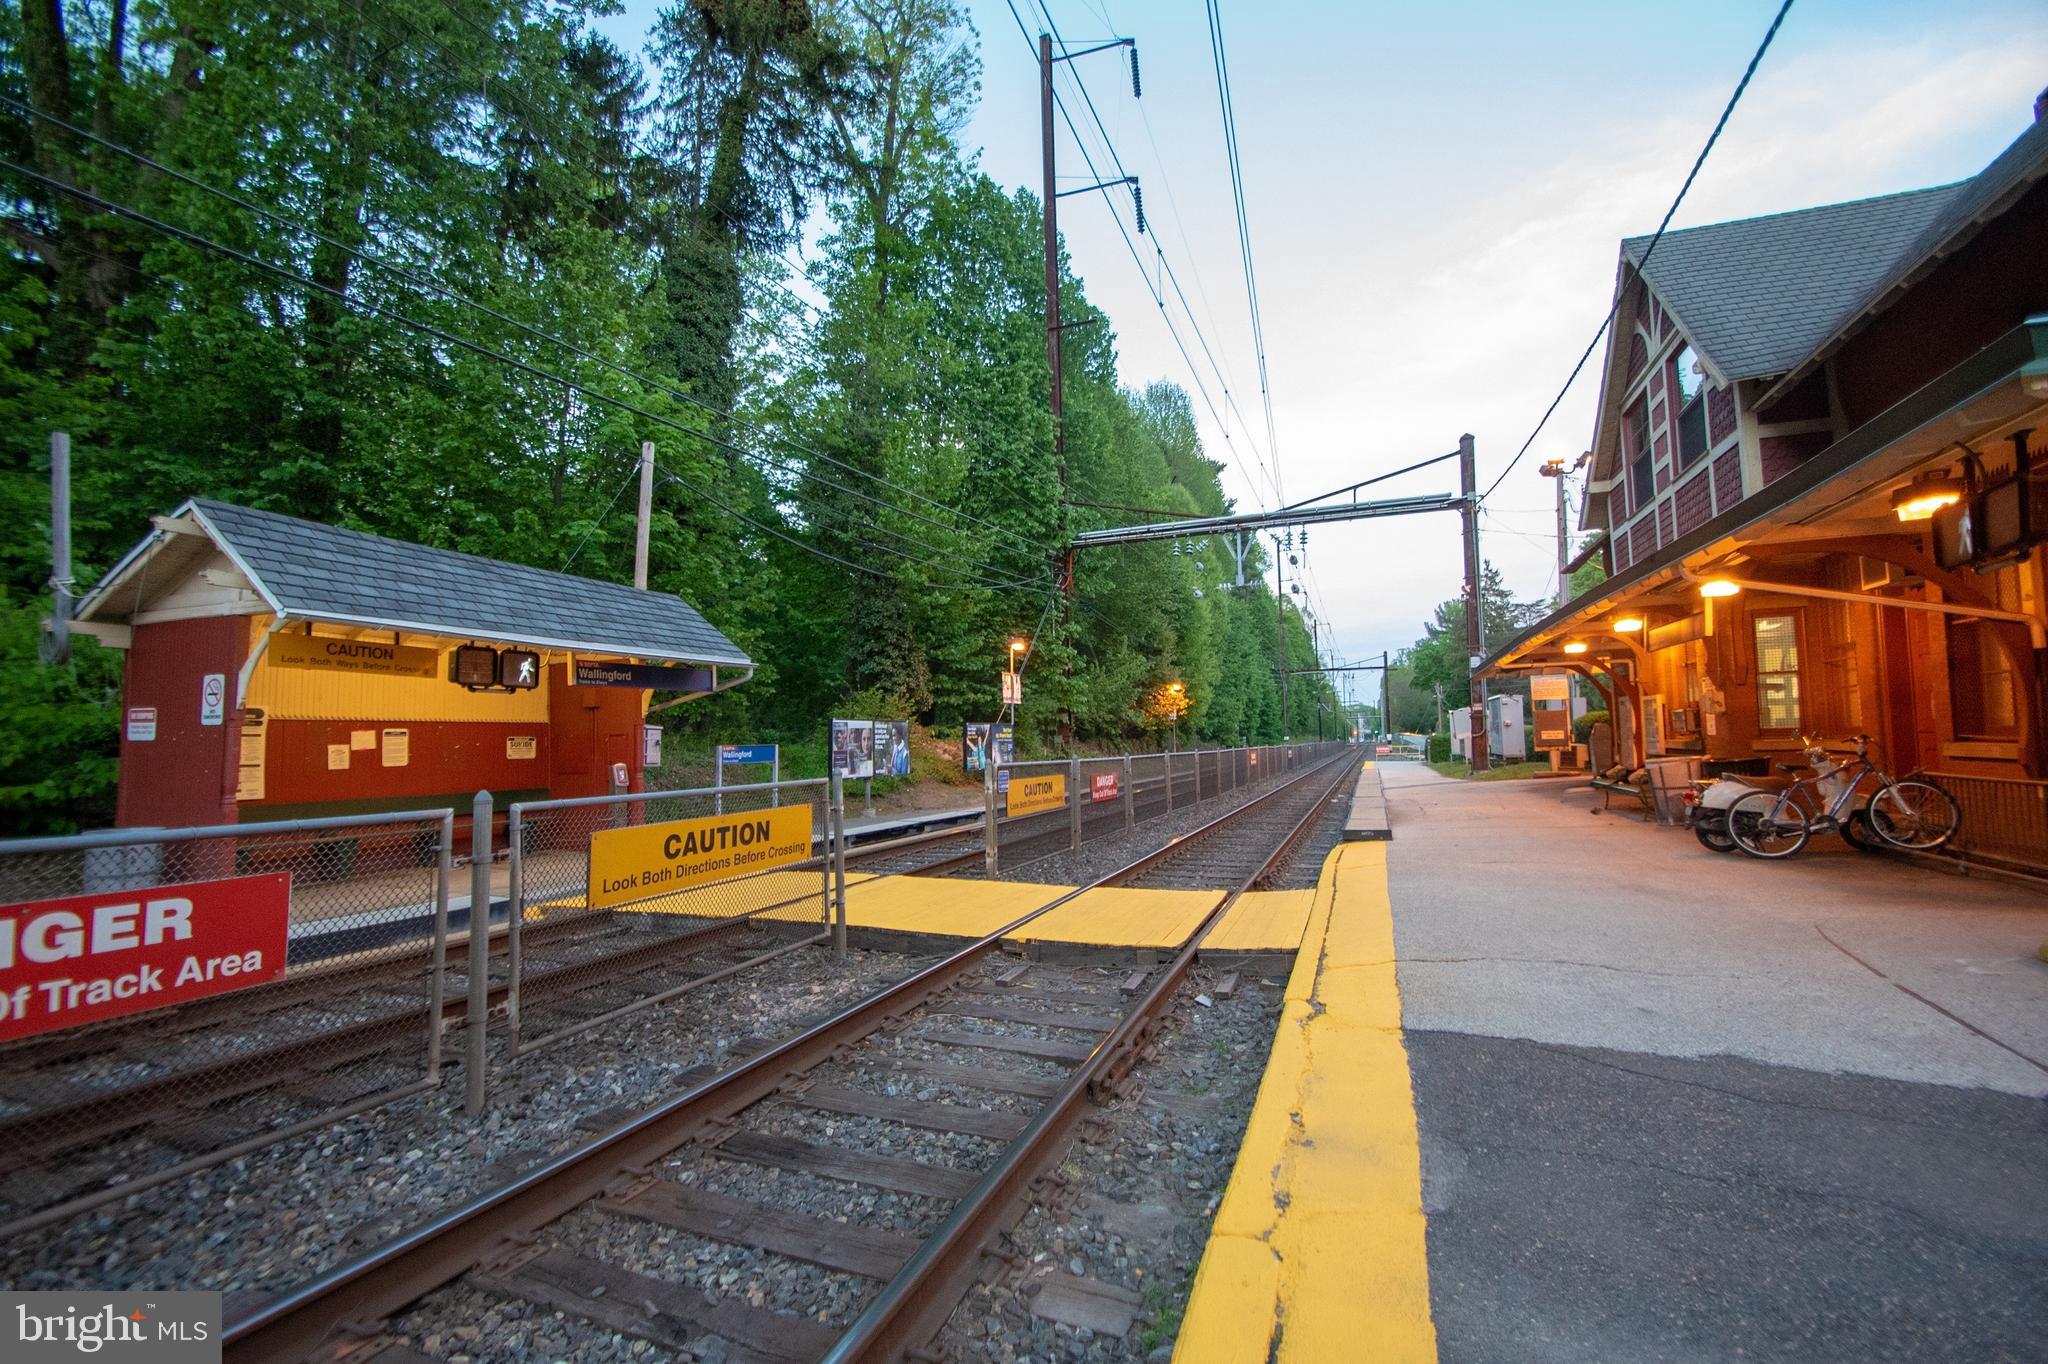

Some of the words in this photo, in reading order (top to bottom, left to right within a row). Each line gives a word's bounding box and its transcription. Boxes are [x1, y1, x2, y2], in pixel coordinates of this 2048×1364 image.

[326, 642, 393, 660] CAUTION
[281, 655, 305, 665] Look
[310, 657, 332, 667] Both
[363, 661, 391, 672] Before
[578, 667, 632, 682] Wallingford
[723, 750, 753, 760] Wallingford
[1024, 782, 1053, 797] CAUTION
[664, 820, 770, 860] CAUTION
[603, 874, 637, 894] Look
[642, 866, 672, 886] Both
[676, 855, 731, 879] Directions
[734, 849, 766, 866] Before
[768, 842, 806, 859] Crossing
[0, 897, 193, 971] GER
[38, 963, 164, 1013] Track
[174, 950, 262, 988] Area
